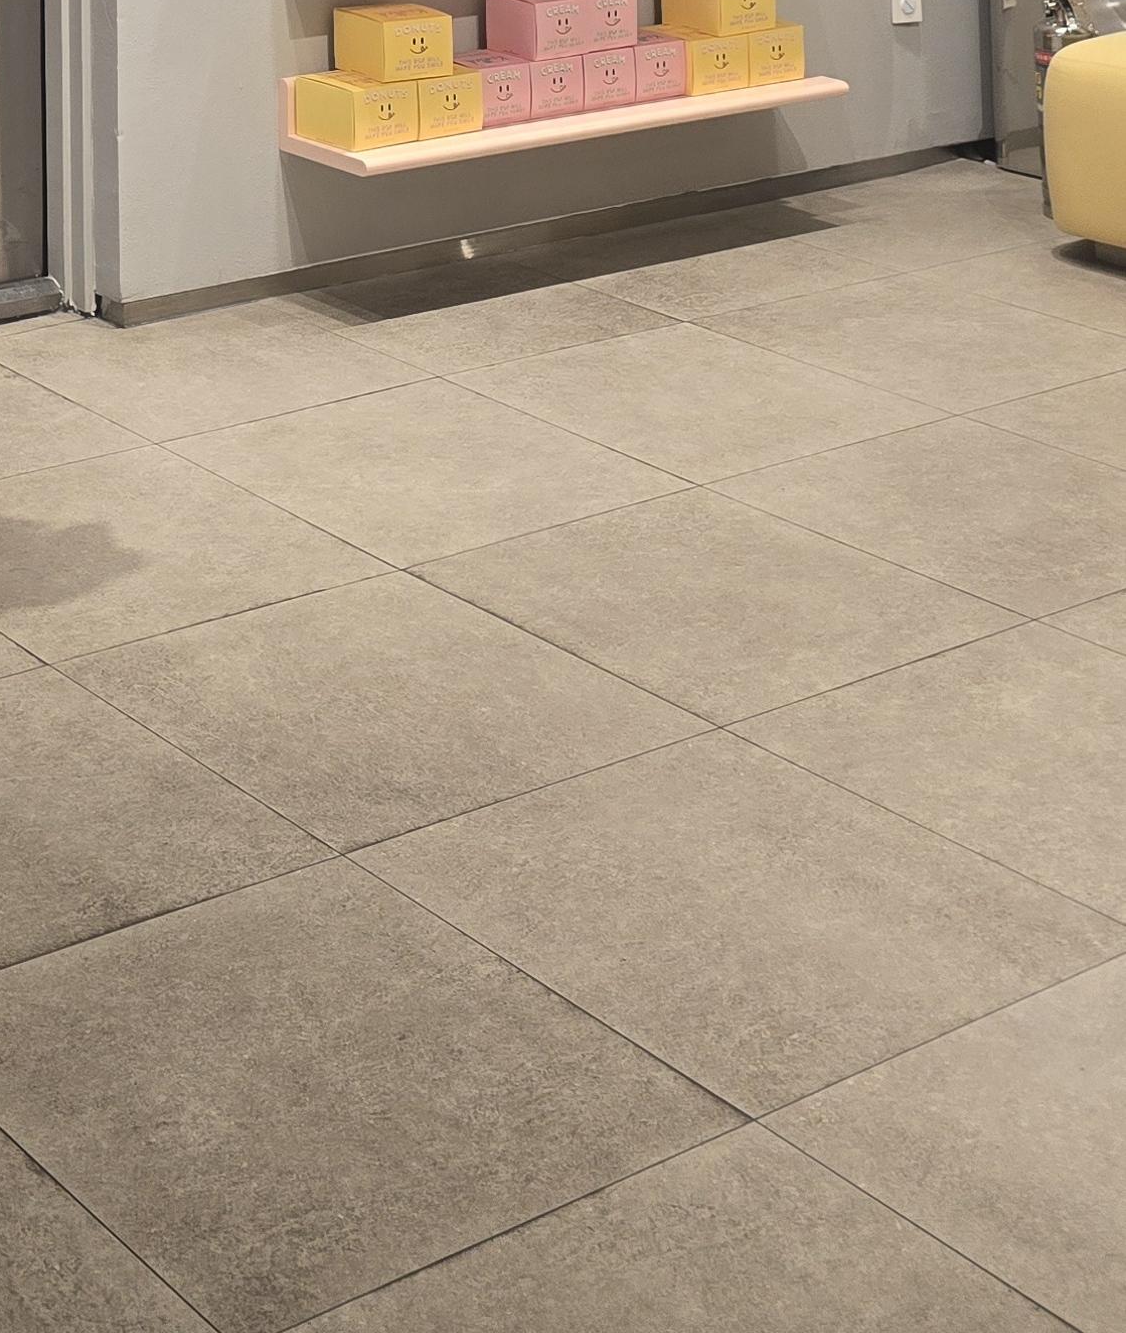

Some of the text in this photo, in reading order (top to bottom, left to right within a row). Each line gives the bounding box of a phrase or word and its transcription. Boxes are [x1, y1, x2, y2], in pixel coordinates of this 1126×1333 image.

[546, 4, 580, 18] CREAM
[394, 22, 443, 37] DONUTS
[645, 47, 677, 61] CREAM
[594, 55, 626, 69] CREAM
[540, 62, 574, 77] CREAM
[487, 70, 521, 84] CREAM
[429, 78, 473, 95] DONUTS
[364, 88, 408, 105] DONUTS
